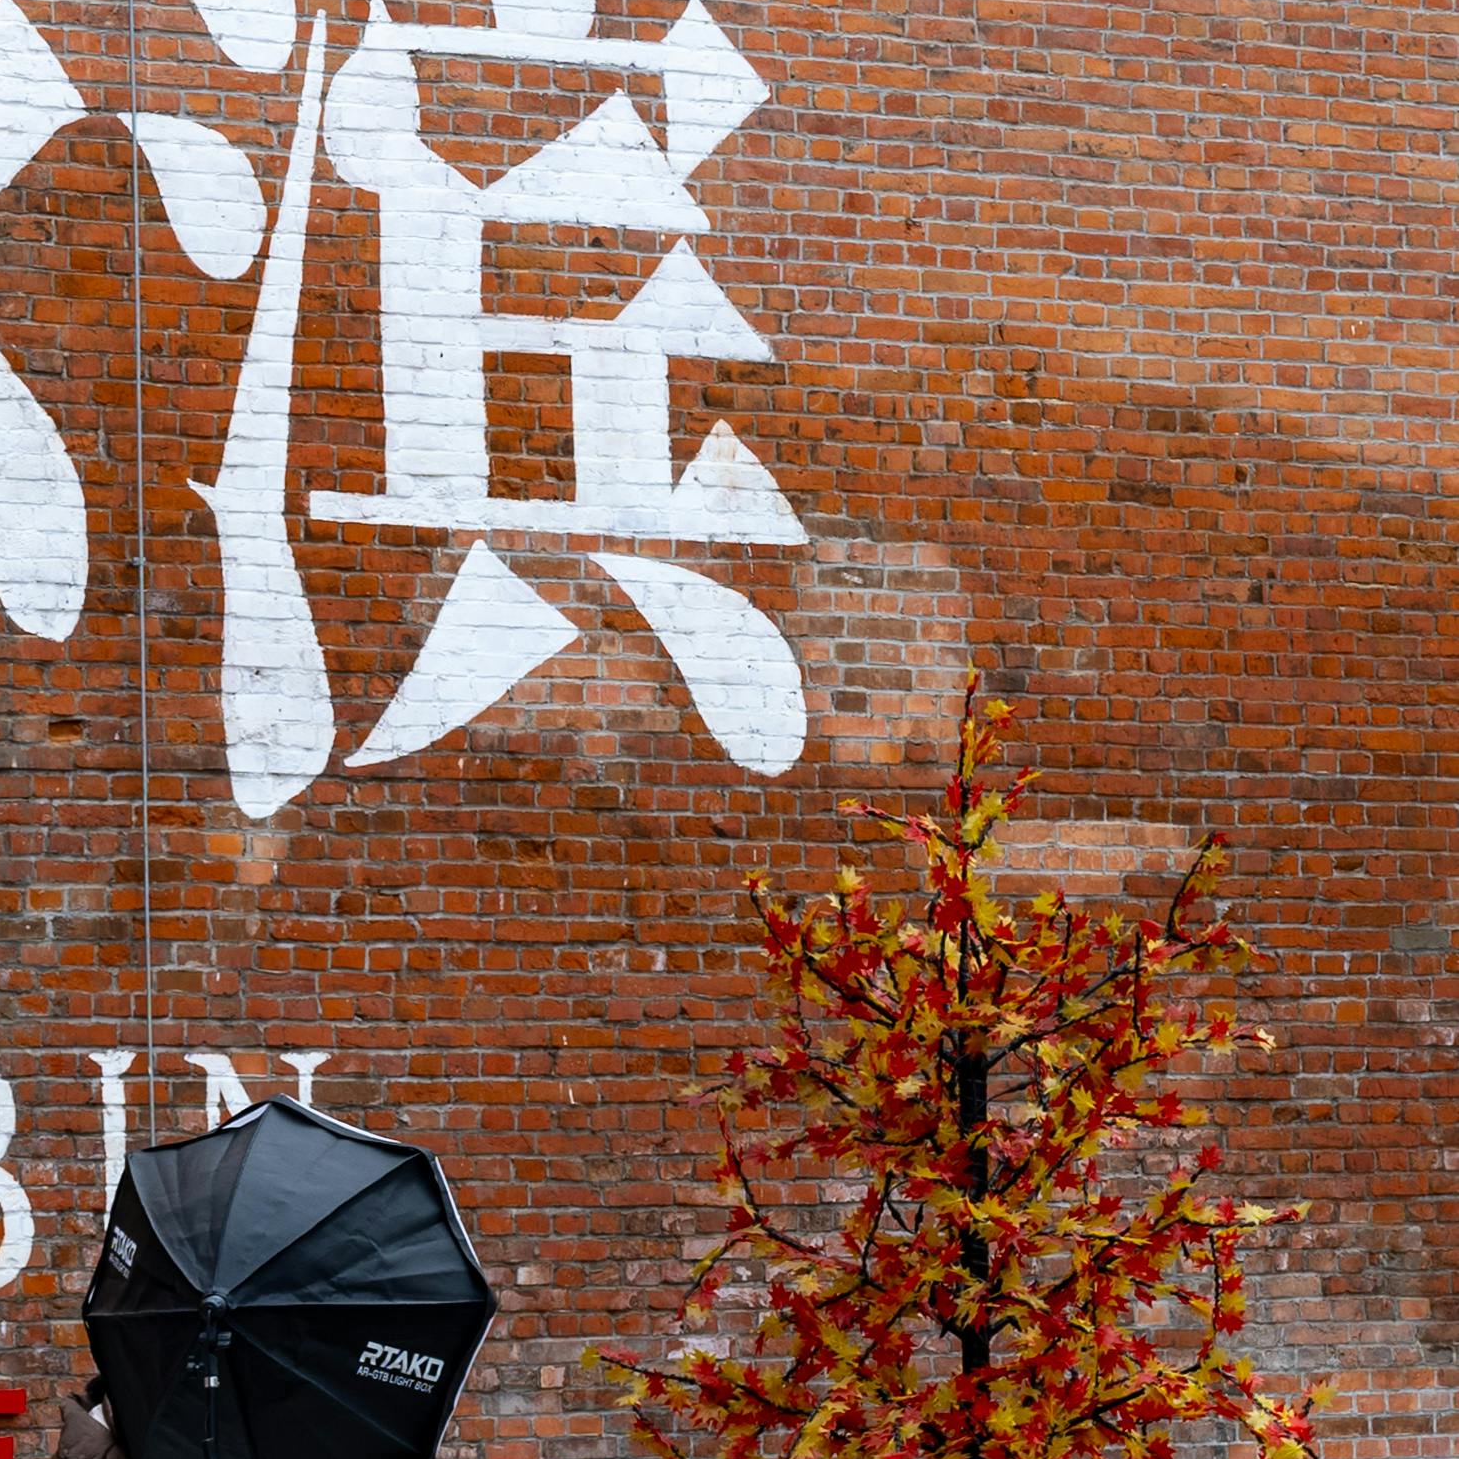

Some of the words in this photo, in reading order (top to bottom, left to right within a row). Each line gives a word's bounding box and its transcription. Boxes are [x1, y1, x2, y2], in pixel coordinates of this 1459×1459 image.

[358, 1341, 445, 1383] RTAKO
[388, 1374, 415, 1390] LIGHT
[414, 1380, 435, 1394] BOX
